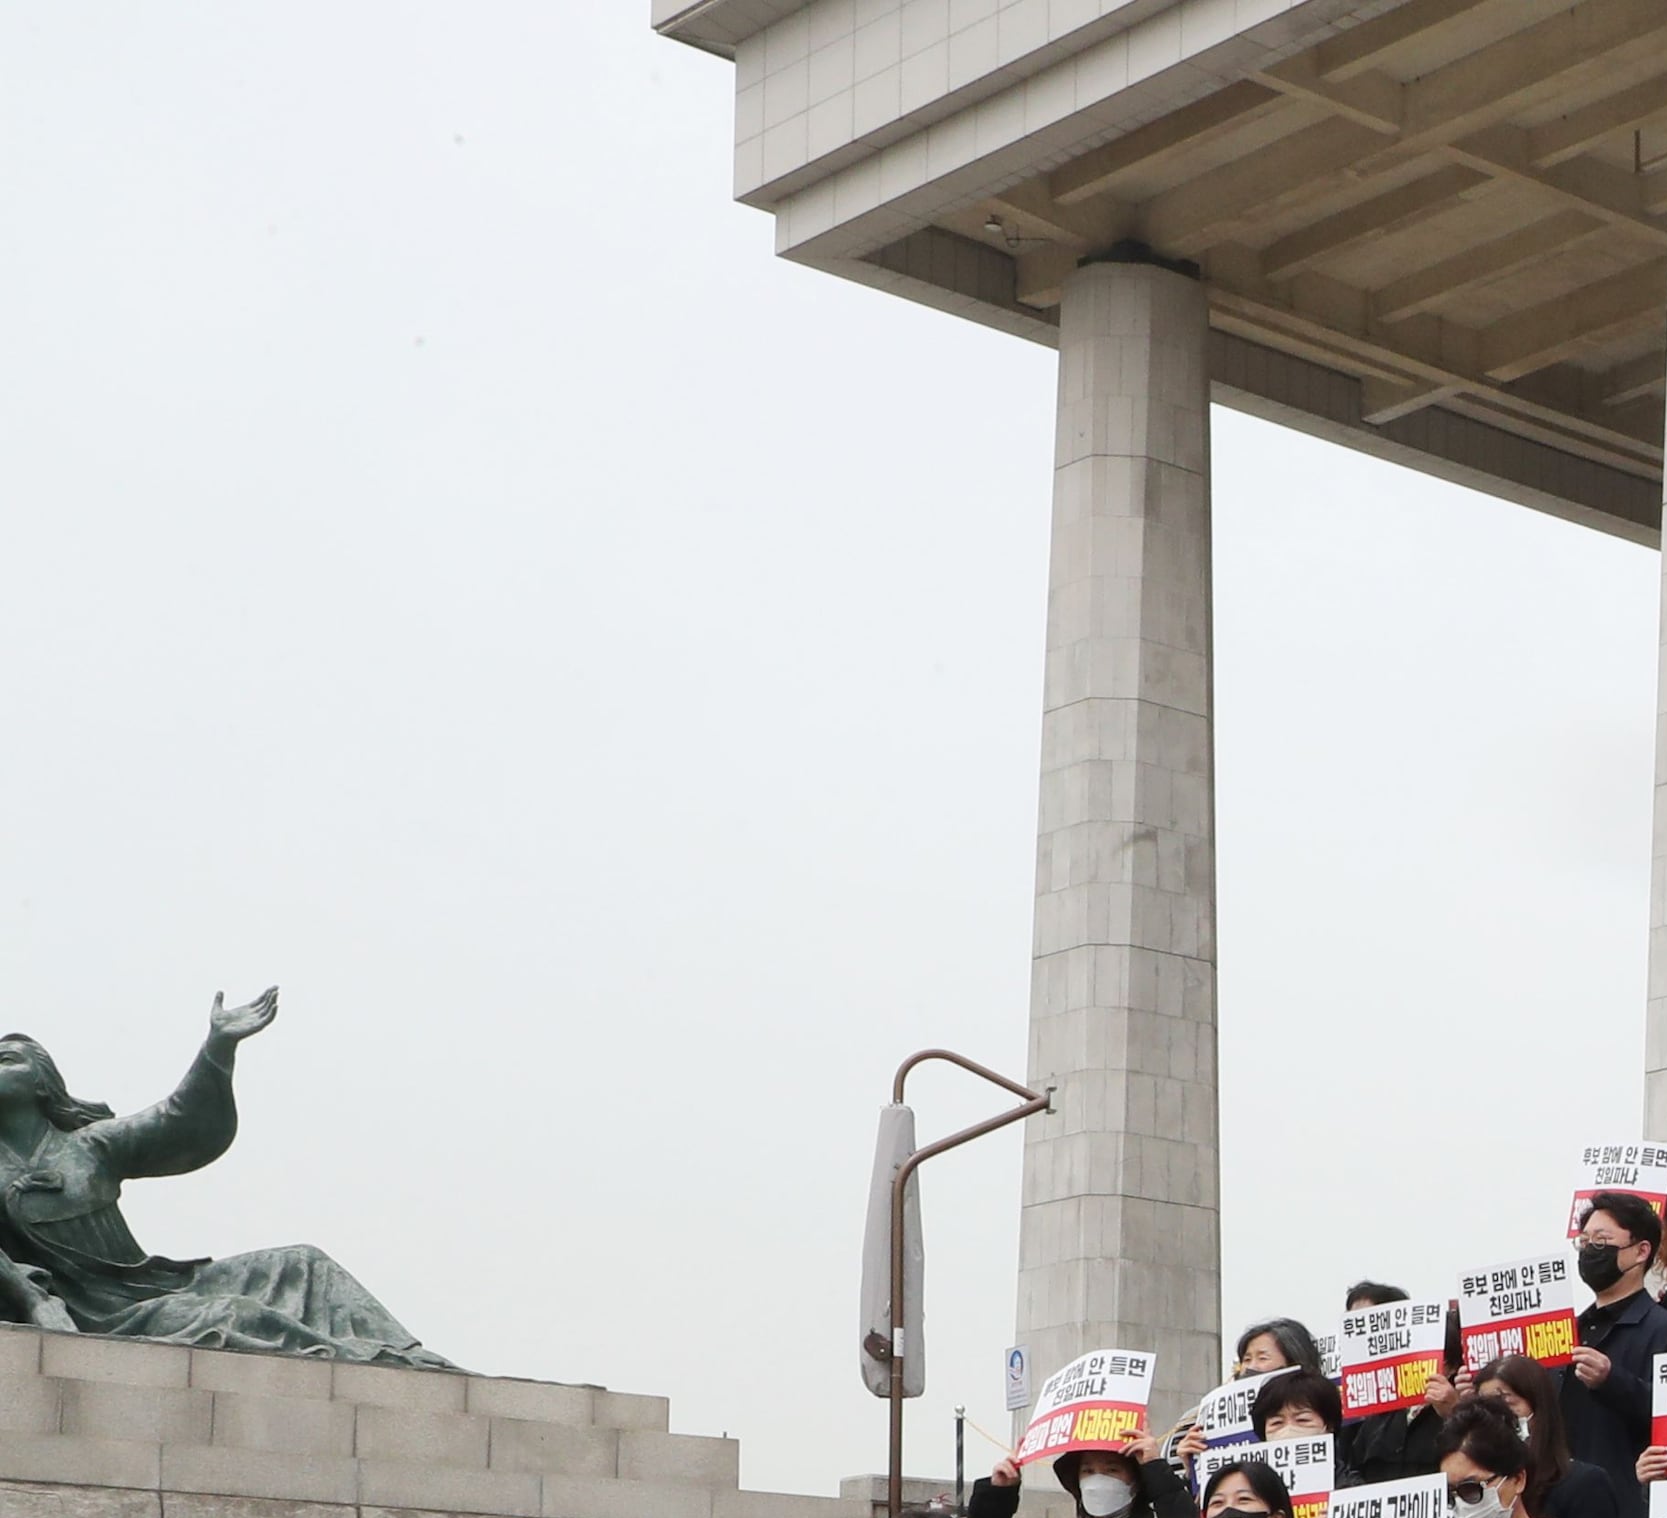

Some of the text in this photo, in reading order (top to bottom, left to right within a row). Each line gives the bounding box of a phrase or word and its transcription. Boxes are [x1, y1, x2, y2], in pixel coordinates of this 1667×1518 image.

[1583, 1149, 1601, 1165] 후보
[1601, 1147, 1622, 1165] 맘에
[1625, 1146, 1638, 1164] 안
[1595, 1166, 1638, 1186] 친일파냐
[1462, 1259, 1566, 1299] 후보 맘에 안 들면
[1489, 1289, 1542, 1318] 친일파냐
[1343, 1304, 1441, 1338] 후보 맘에 안 들면
[1367, 1330, 1411, 1357] 친일파냐
[1274, 1441, 1328, 1471] 안 들면
